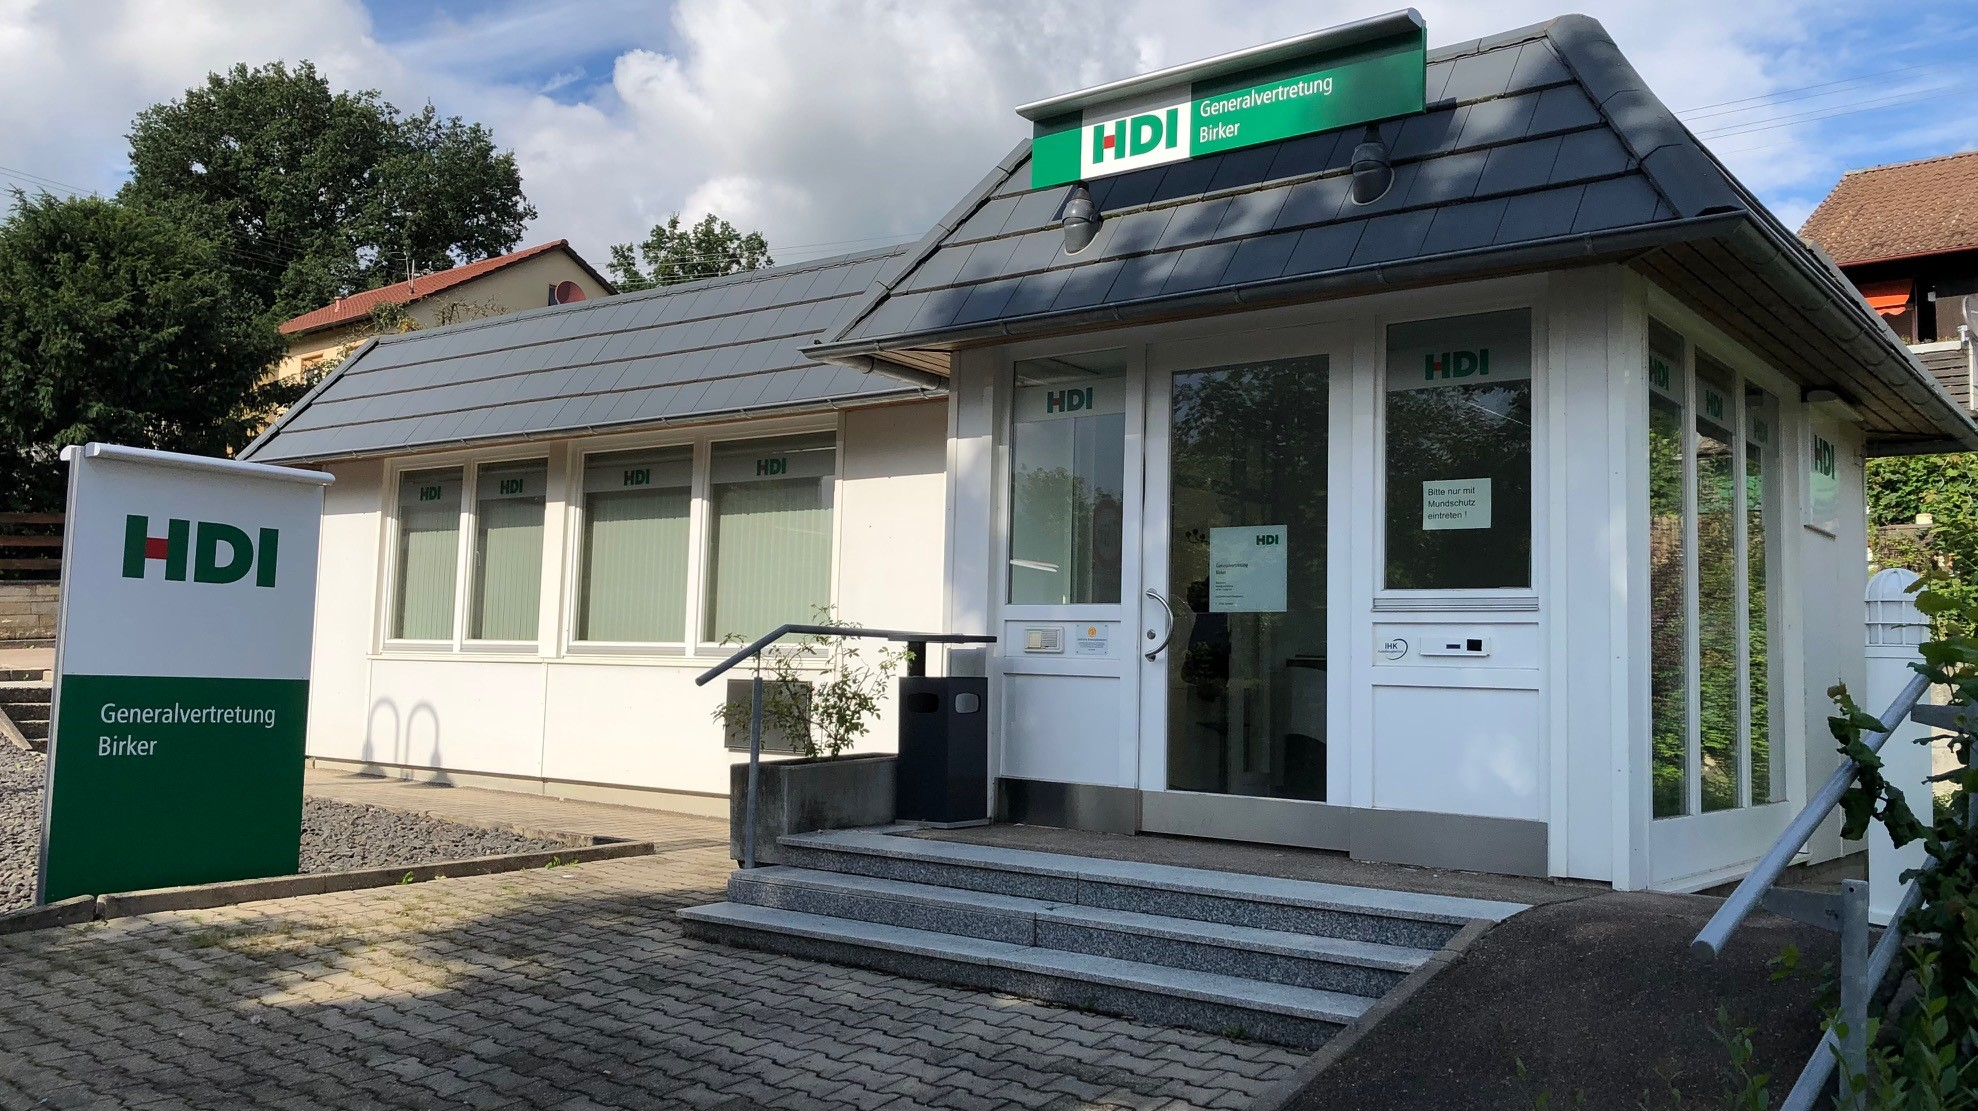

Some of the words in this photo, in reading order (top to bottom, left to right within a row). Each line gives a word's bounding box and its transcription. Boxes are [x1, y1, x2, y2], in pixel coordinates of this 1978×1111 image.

[1200, 76, 1333, 118] Generalvertretung
[1092, 107, 1179, 165] HDI
[1199, 120, 1241, 143] Birker
[1424, 348, 1490, 381] HDI
[1046, 386, 1094, 414] HDI
[1705, 389, 1723, 421] HDI
[756, 457, 787, 476] HDI
[1814, 434, 1836, 480] HDI
[500, 478, 524, 496] HDI
[623, 468, 650, 487] HDI
[419, 485, 442, 502] HDI
[1428, 488, 1446, 496] Bitte
[1428, 499, 1476, 508] Mundschutz
[1428, 511, 1462, 520] eintreten
[1256, 534, 1279, 545] HDI
[121, 514, 280, 588] HDI
[100, 702, 276, 729] Generalvertretung
[98, 735, 158, 757] Birker
